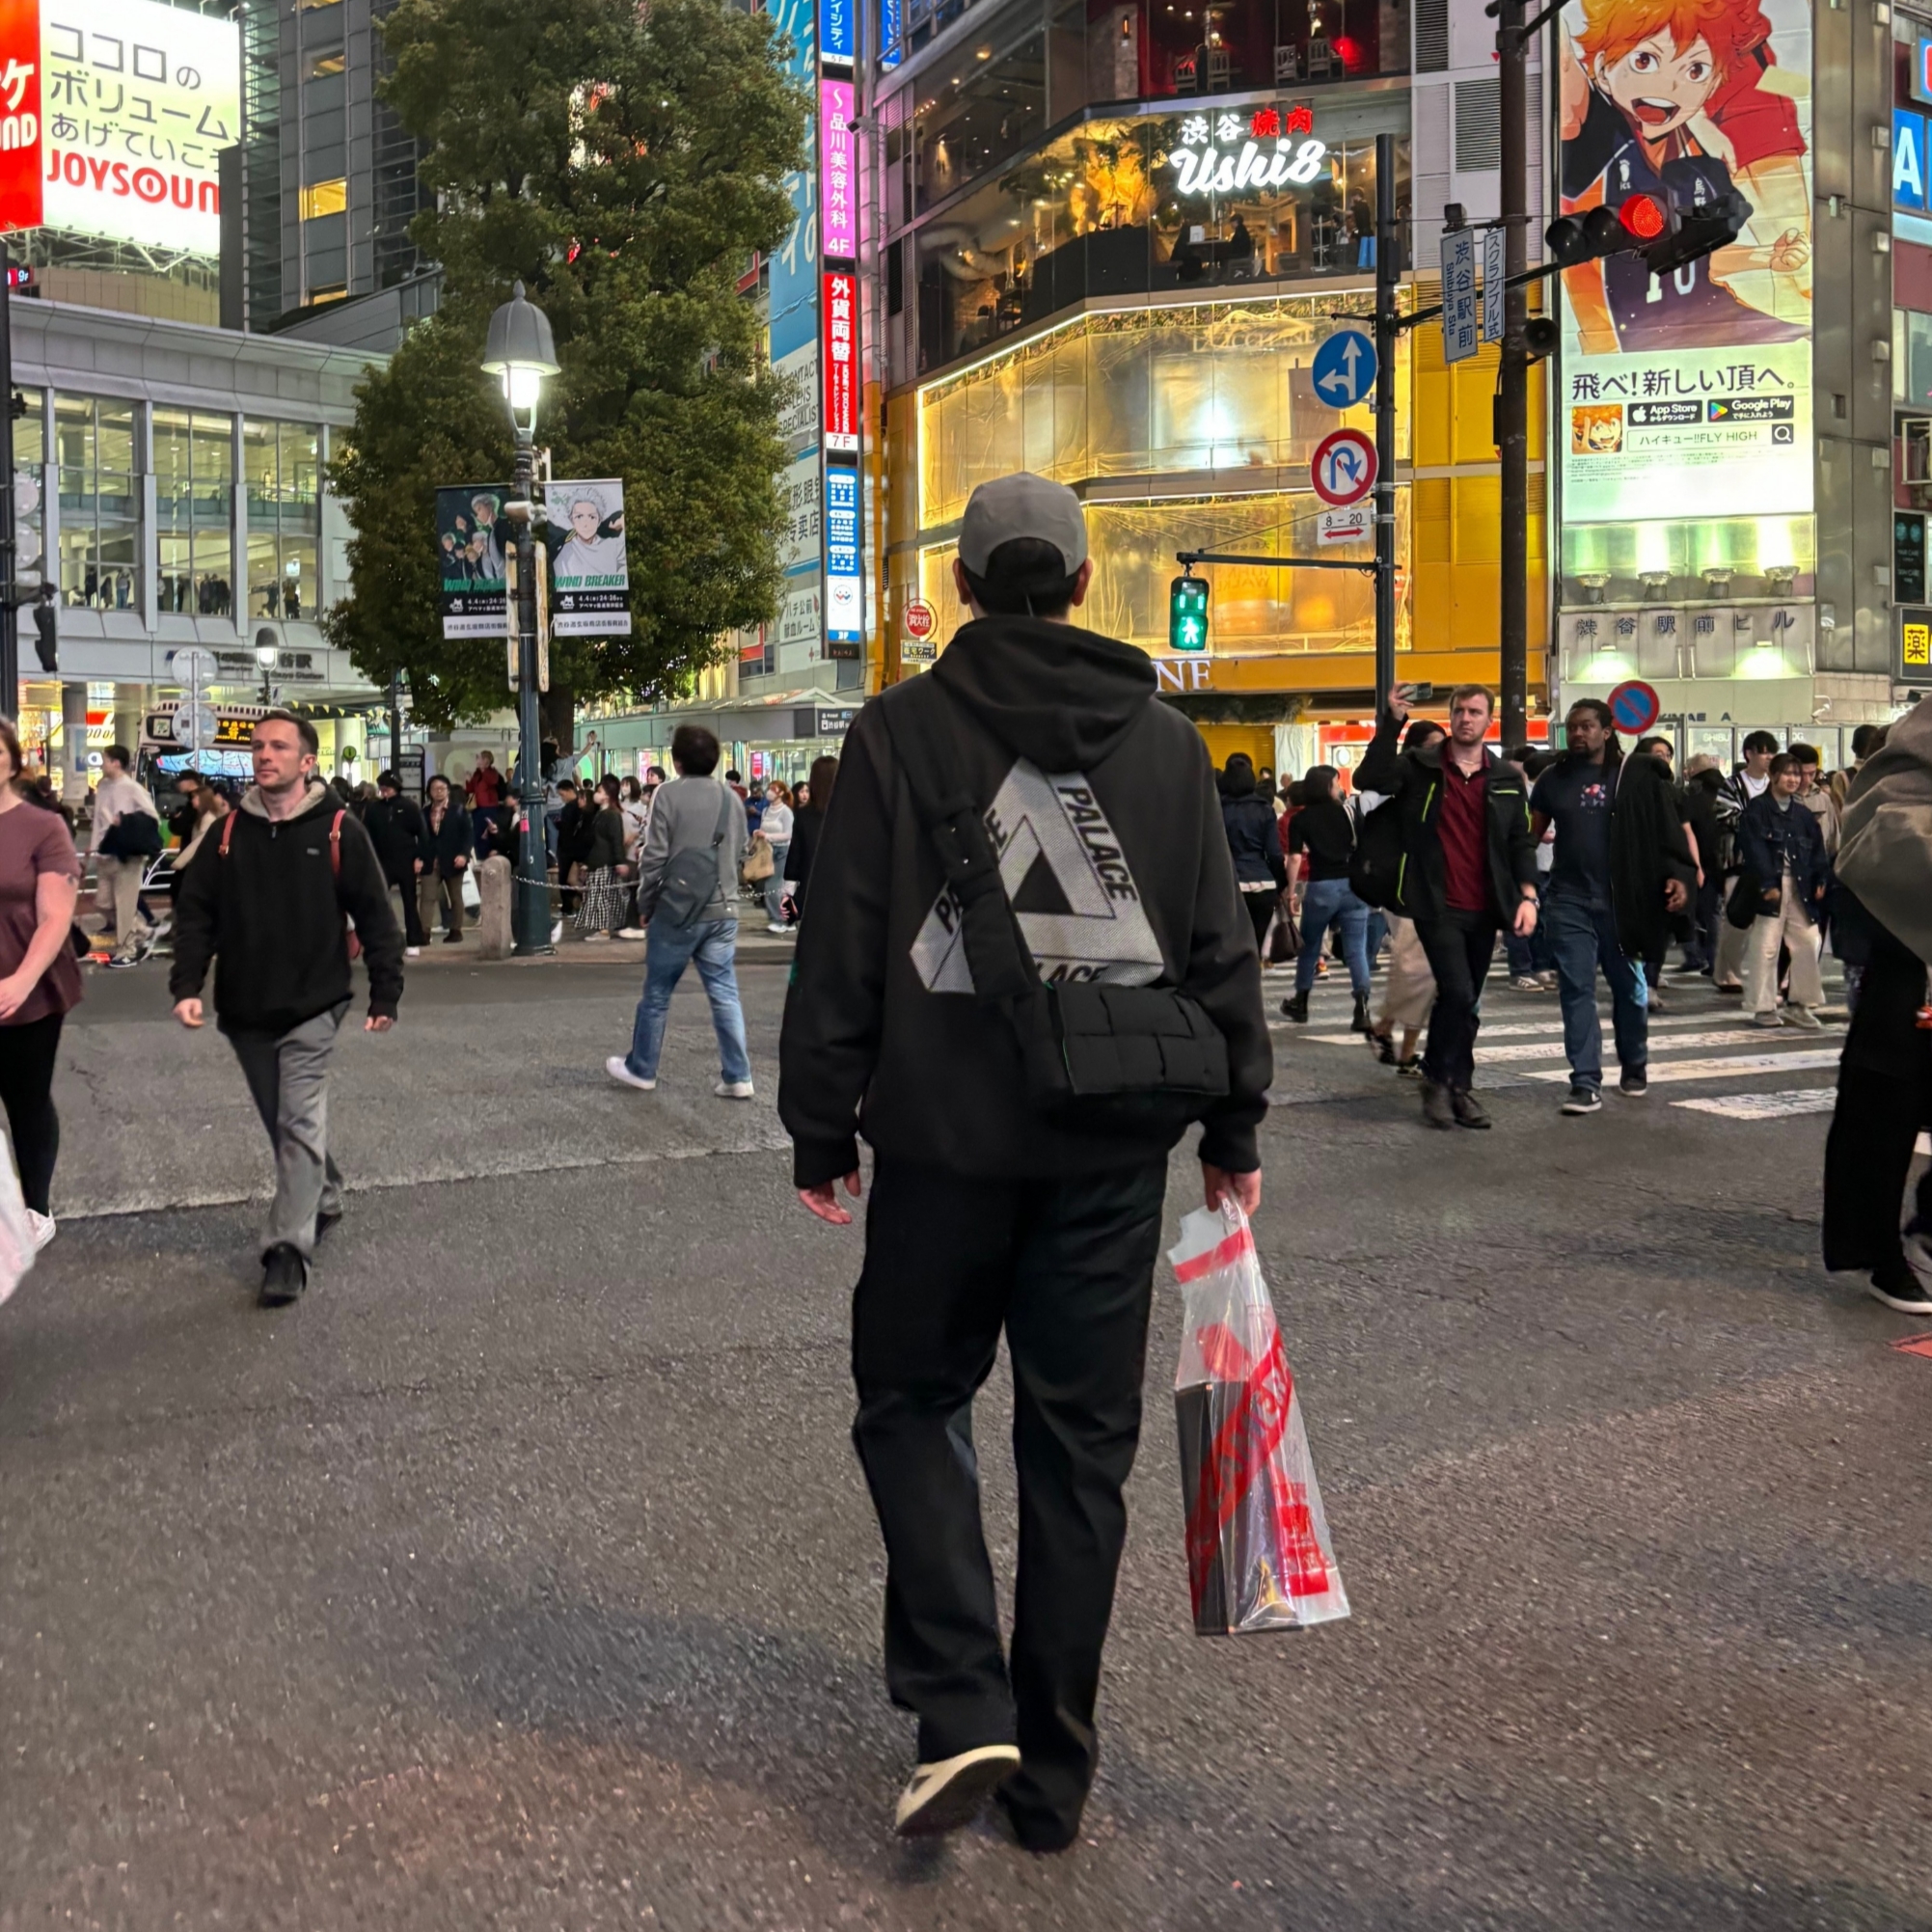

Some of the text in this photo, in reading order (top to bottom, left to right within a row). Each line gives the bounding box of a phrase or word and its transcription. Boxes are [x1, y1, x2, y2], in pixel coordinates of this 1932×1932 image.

[50, 21, 202, 91] ココロの
[0, 58, 35, 112] ケ
[50, 69, 229, 141] ボリューム
[0, 113, 38, 151] ND
[1181, 104, 1314, 146] 渋谷焼肉
[1169, 138, 1326, 195] Ushi8
[828, 237, 850, 254] 4F
[1446, 261, 1456, 312] Shibuya
[1455, 240, 1473, 349] 渋谷駅前
[830, 276, 851, 363] 外貨両替
[777, 403, 818, 437] SPECIALIS
[1649, 403, 1698, 422] App Store
[1731, 397, 1792, 413] Google Play
[1726, 430, 1757, 442] HIGH
[1325, 516, 1333, 527] 8
[1348, 512, 1363, 524] 20
[554, 574, 626, 587] WIND BREAKER
[1576, 611, 1796, 637] 渋谷駅前ビル
[1907, 630, 1926, 660] 薬
[1702, 731, 1742, 743] SHIBUA
[1058, 786, 1138, 903] PALACE
